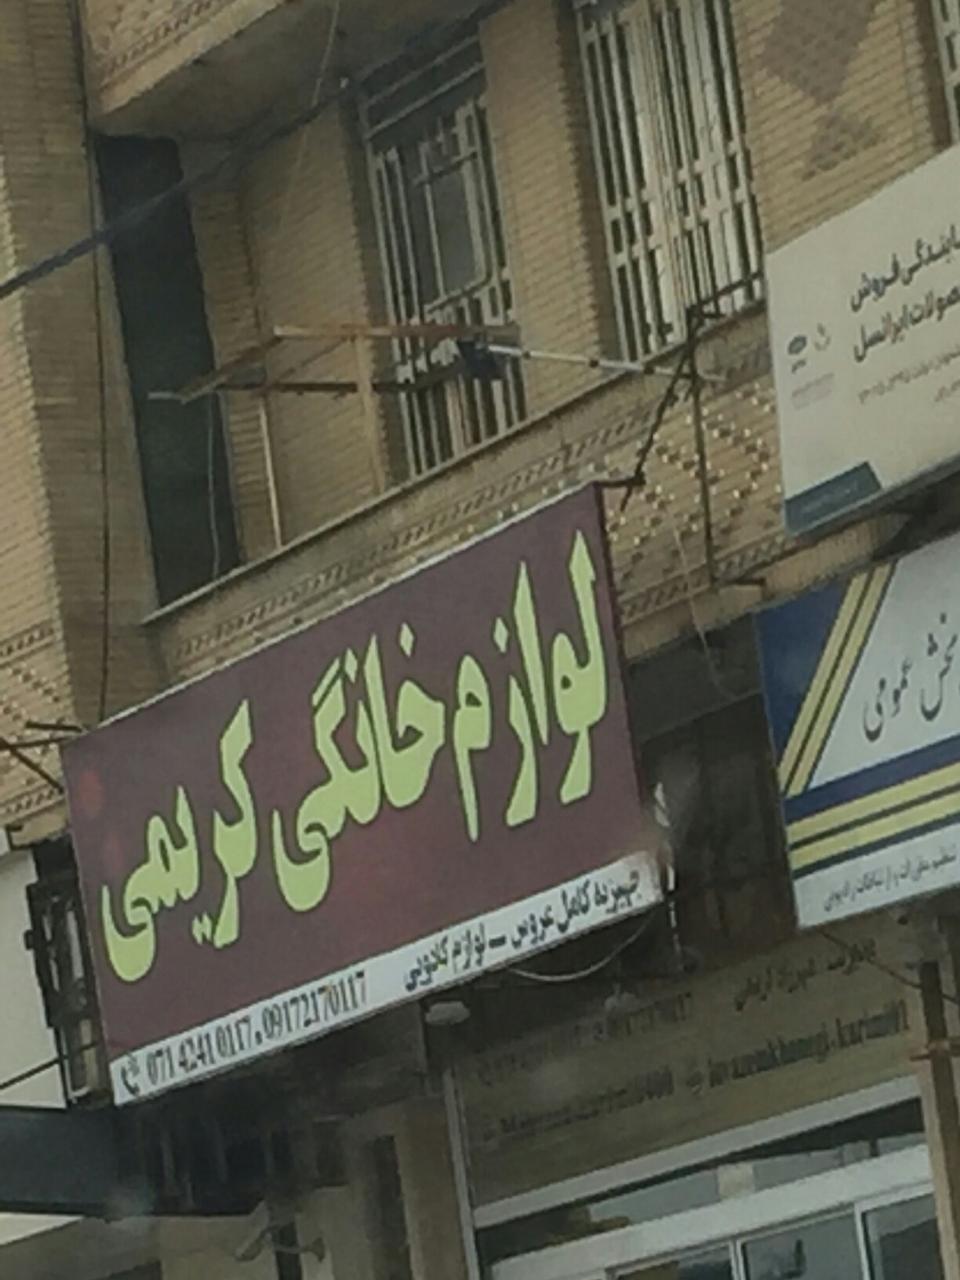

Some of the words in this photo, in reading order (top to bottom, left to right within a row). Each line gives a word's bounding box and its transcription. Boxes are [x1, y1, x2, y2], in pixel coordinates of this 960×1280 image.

[851, 253, 900, 313] فروش
[272, 622, 446, 912] خانگی
[452, 530, 607, 843] لوازم
[863, 656, 912, 743] عمومی
[101, 699, 258, 982] کریمی
